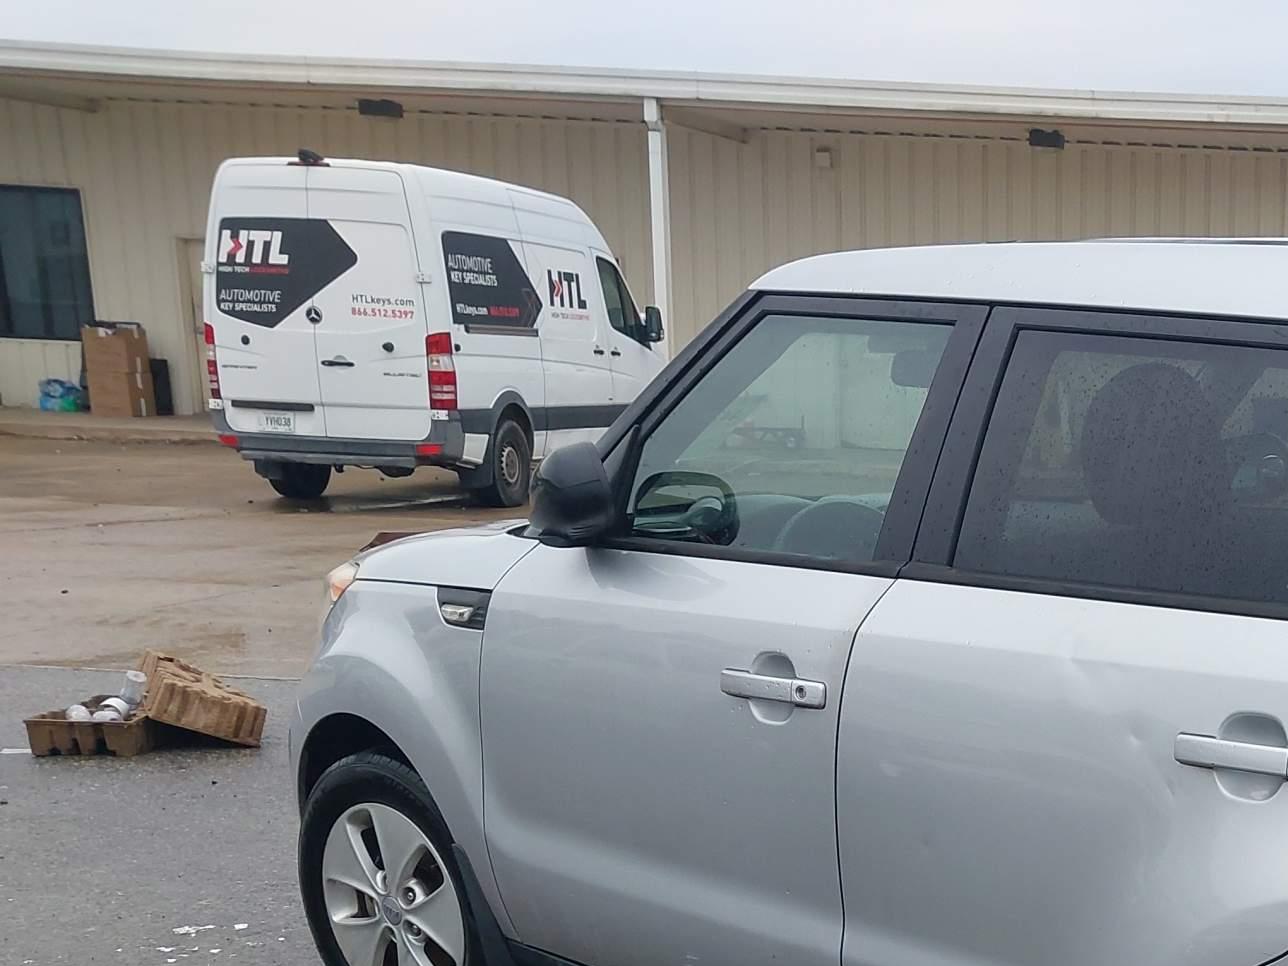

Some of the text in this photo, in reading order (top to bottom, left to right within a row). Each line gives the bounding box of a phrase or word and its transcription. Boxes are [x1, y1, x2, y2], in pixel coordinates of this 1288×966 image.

[218, 229, 289, 265] HTL
[447, 254, 493, 273] AUTOMOTIVE
[450, 271, 498, 287] KEY SPECIALISTS
[219, 289, 281, 302] AUTOMOTIVE
[547, 269, 588, 310] HTL
[220, 302, 277, 313] KEY SPECIALISTS
[351, 294, 415, 306] HTLkeys.com
[351, 306, 415, 320] 866.512.5397
